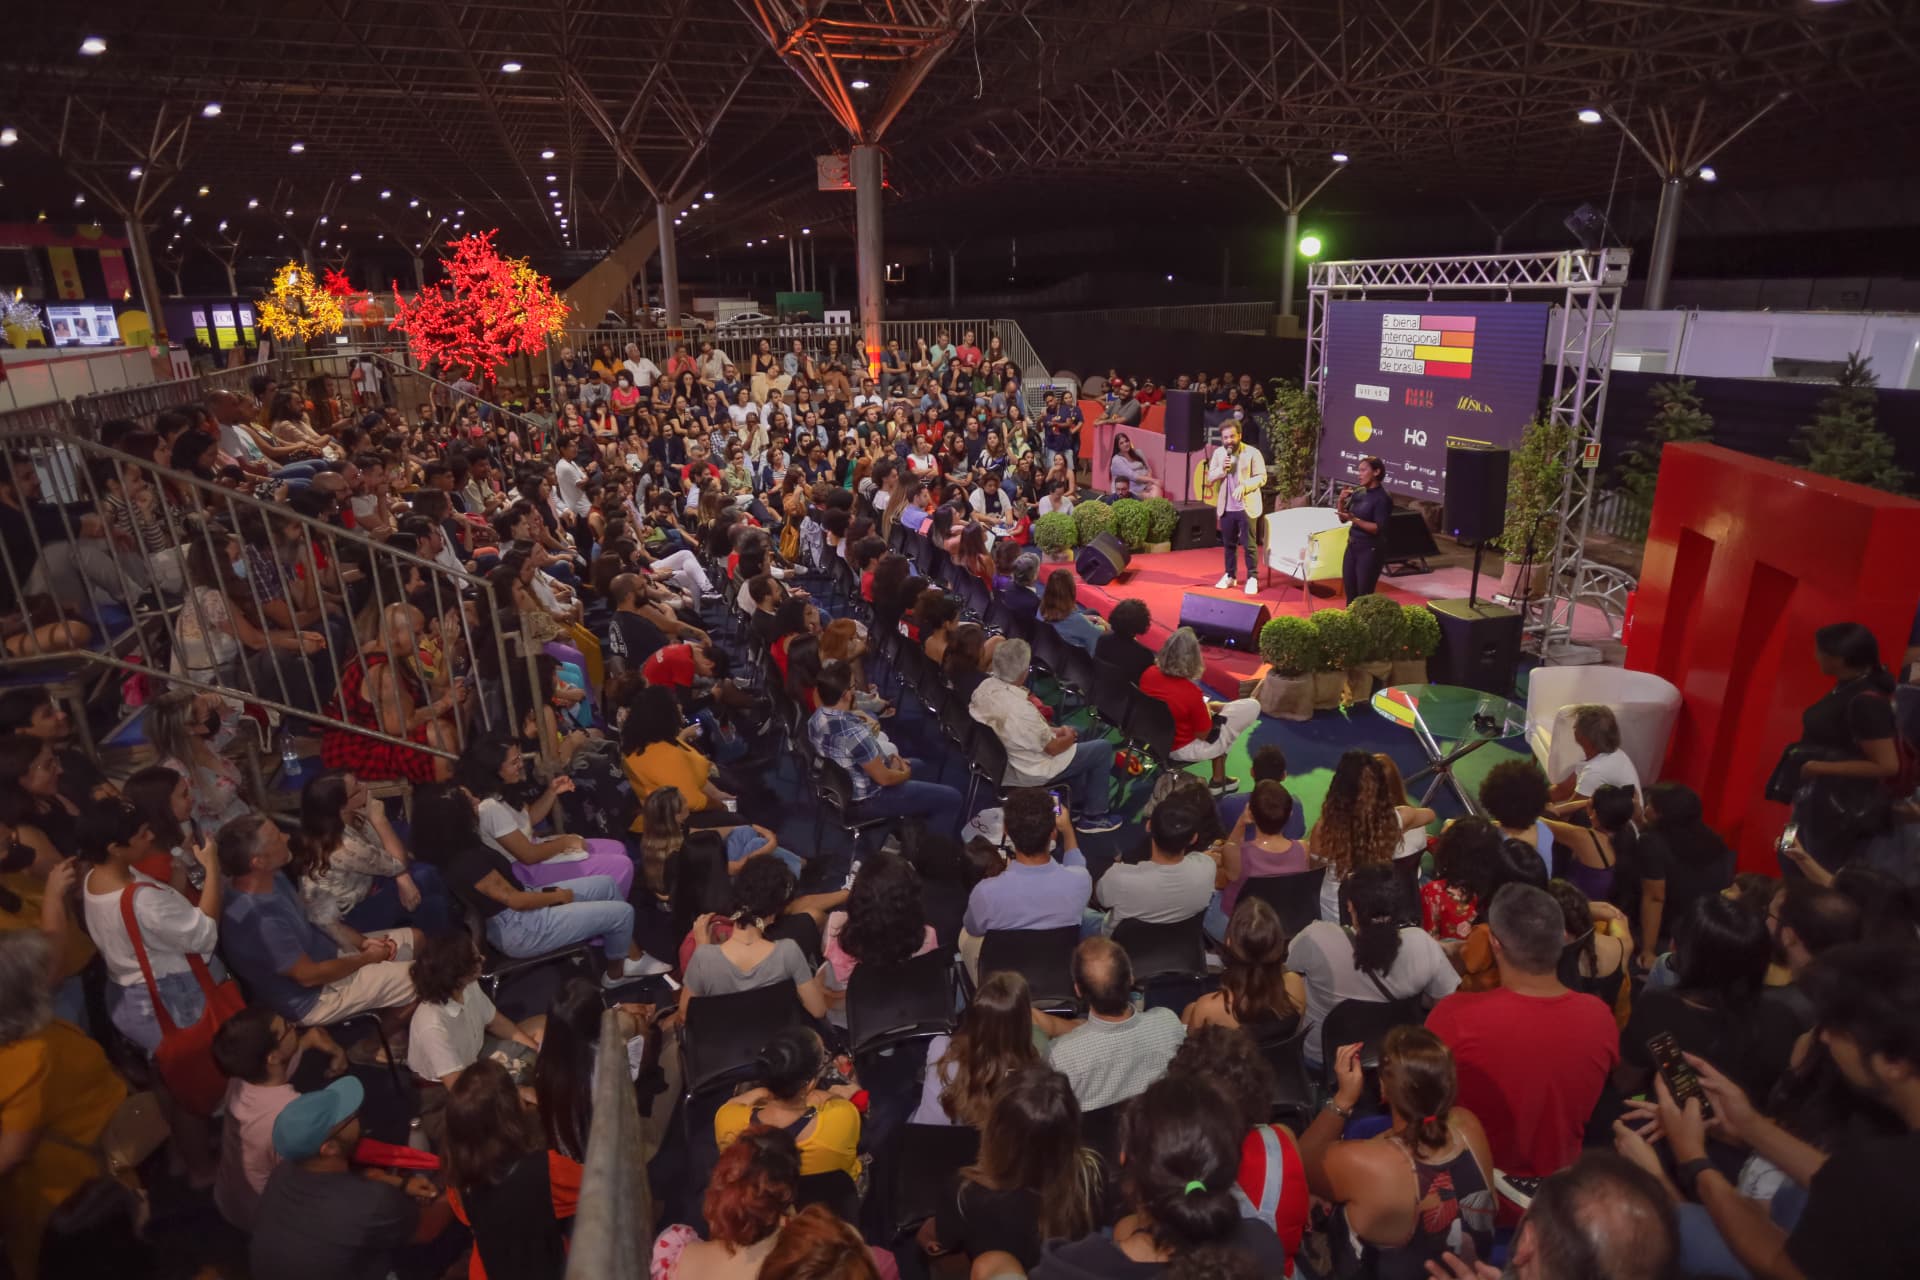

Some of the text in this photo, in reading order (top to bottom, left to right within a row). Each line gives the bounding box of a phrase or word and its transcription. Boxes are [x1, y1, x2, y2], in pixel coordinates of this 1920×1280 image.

[1393, 317, 1419, 329] bienal
[1382, 331, 1440, 345] internacional
[1382, 345, 1412, 357] do livro
[1382, 359, 1391, 370] de
[1404, 428, 1427, 447] HQ
